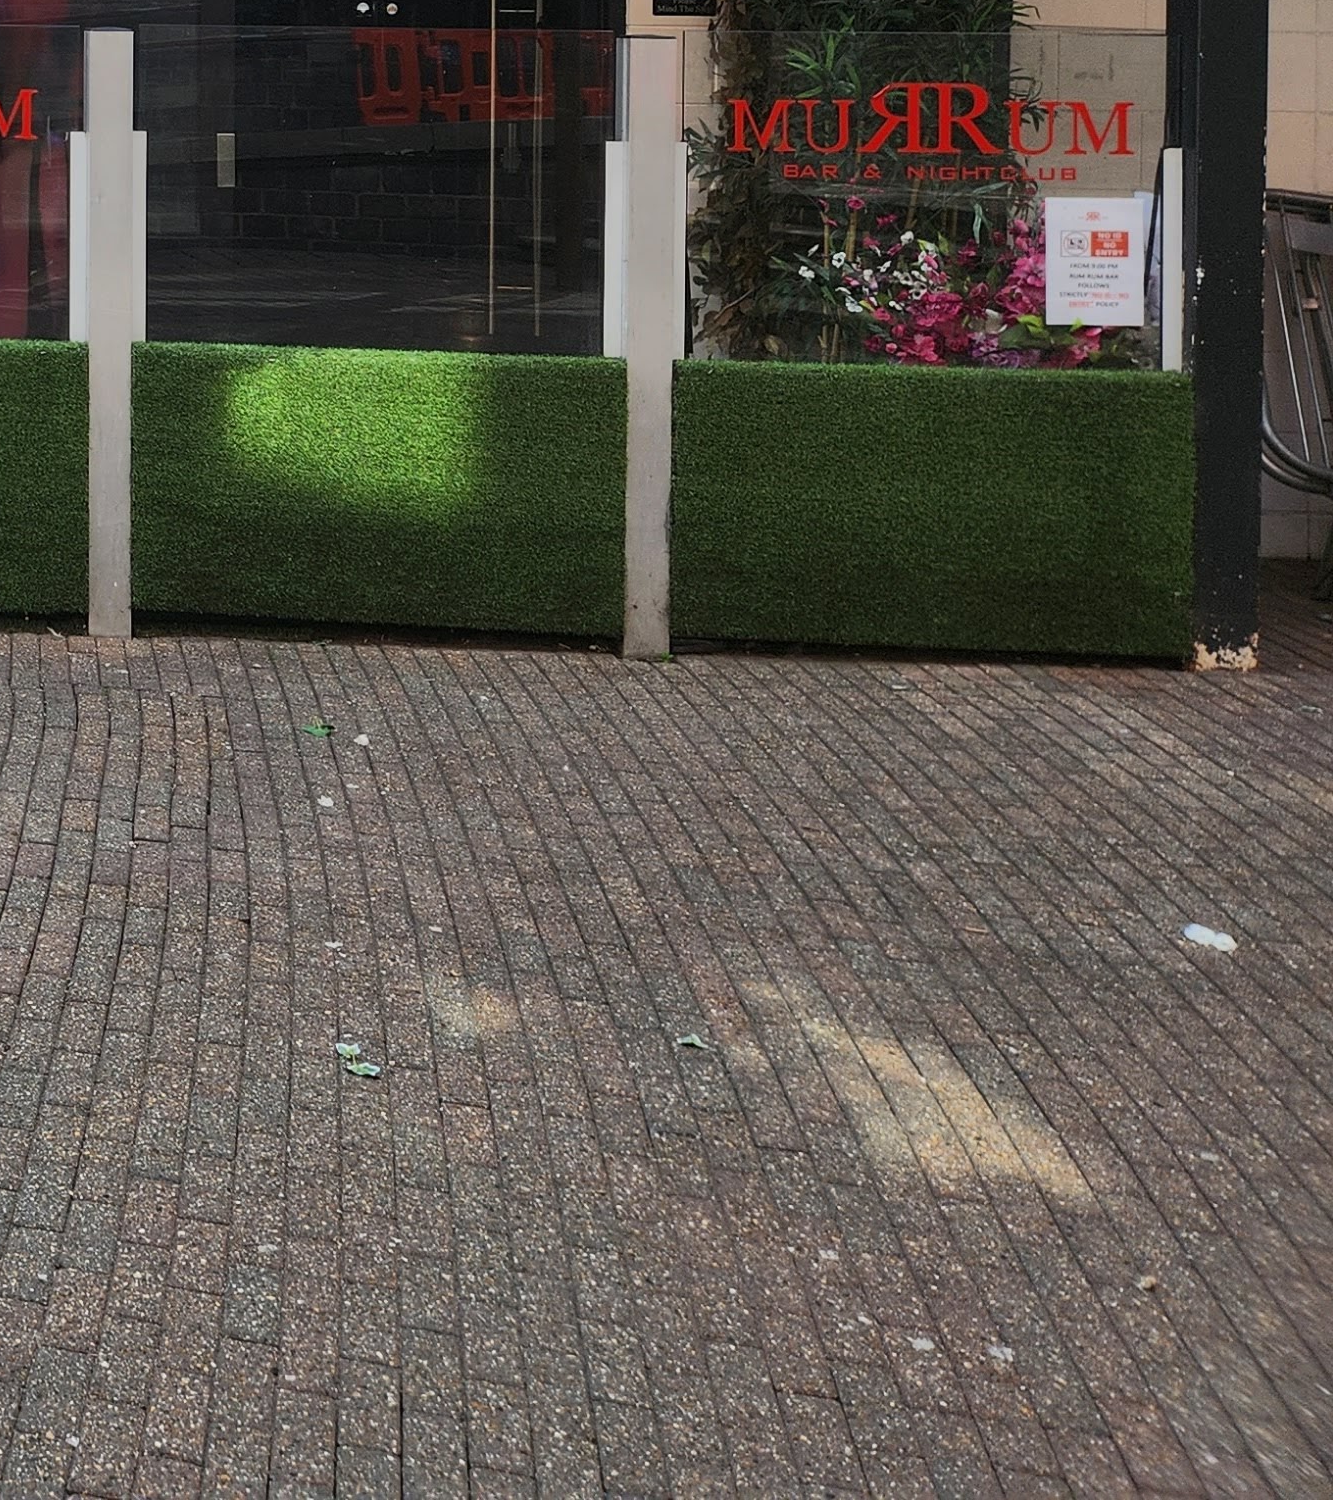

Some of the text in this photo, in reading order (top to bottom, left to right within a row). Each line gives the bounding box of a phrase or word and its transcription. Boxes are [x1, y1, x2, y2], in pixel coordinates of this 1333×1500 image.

[783, 164, 1077, 181] BAR & NIGHTCLUB
